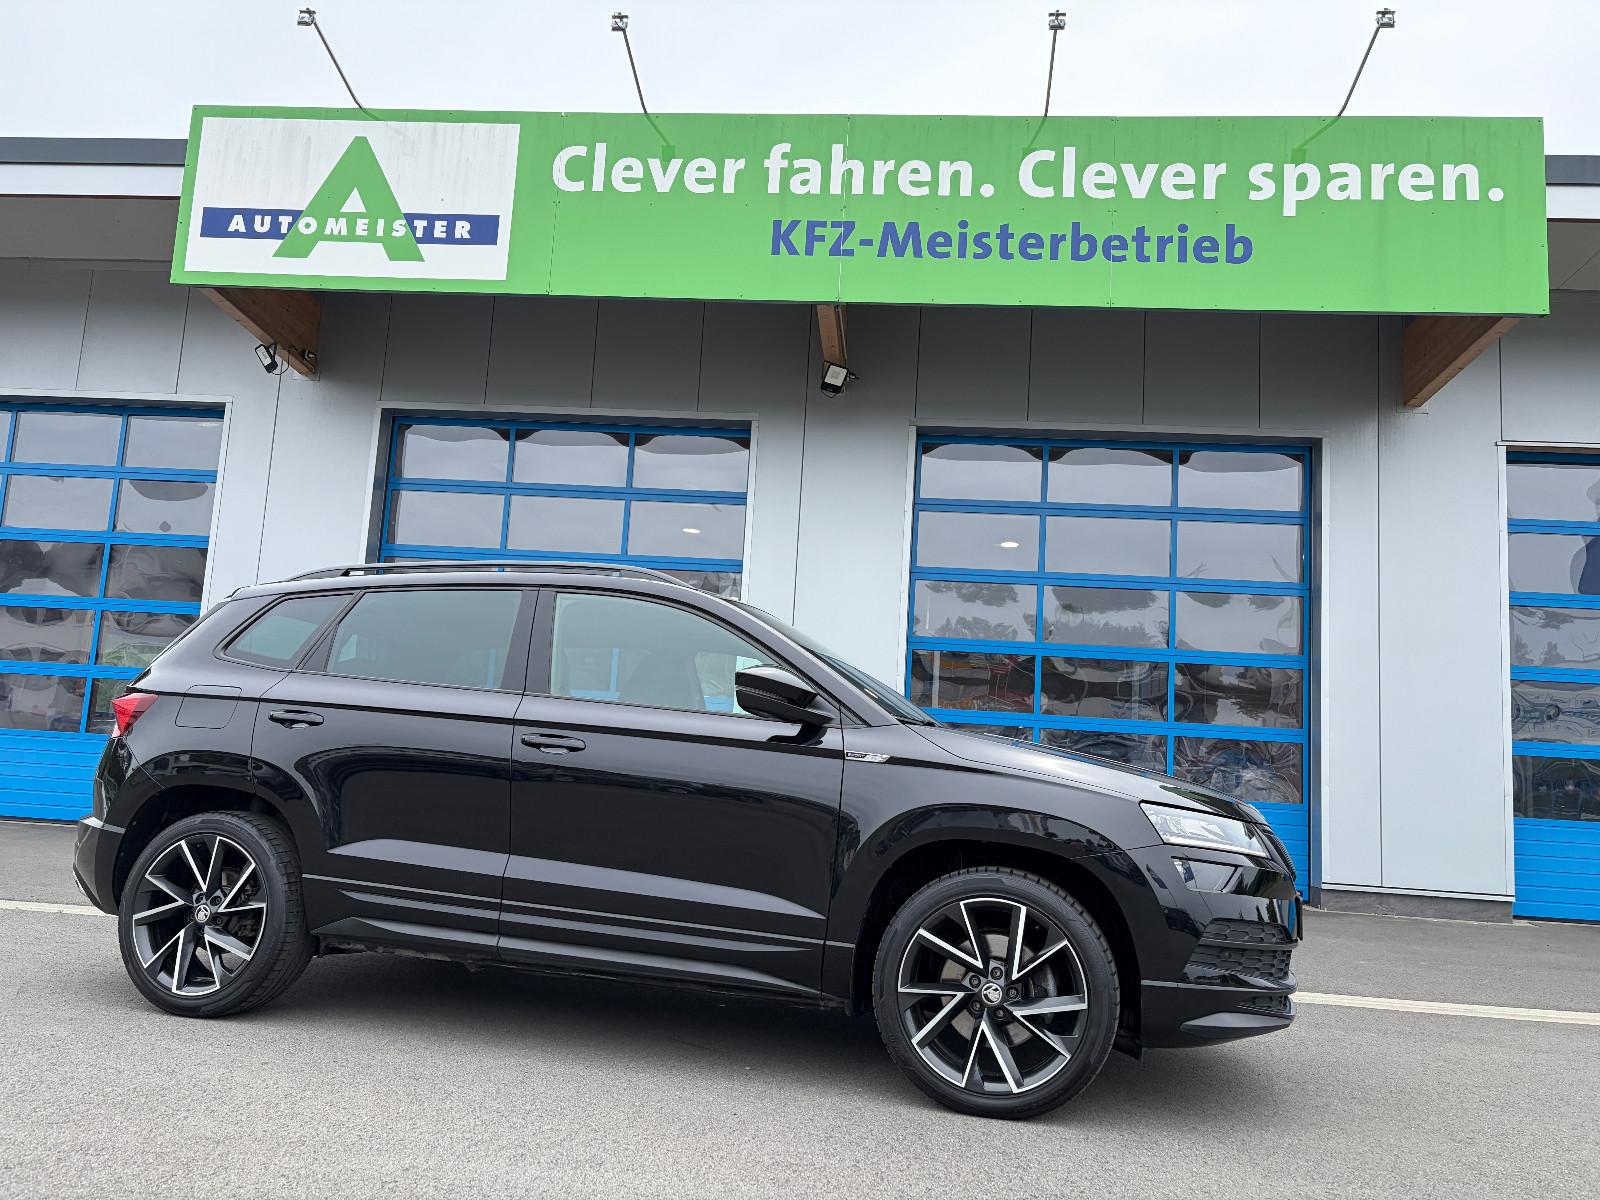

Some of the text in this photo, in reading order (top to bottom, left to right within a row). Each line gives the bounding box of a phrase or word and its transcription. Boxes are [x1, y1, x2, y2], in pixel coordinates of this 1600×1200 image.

[551, 142, 1505, 217] Clever fahren. Clever sparen.
[227, 213, 472, 240] AUTOMEISTER
[770, 219, 1254, 264] KFZ-Meisterbetrieb
